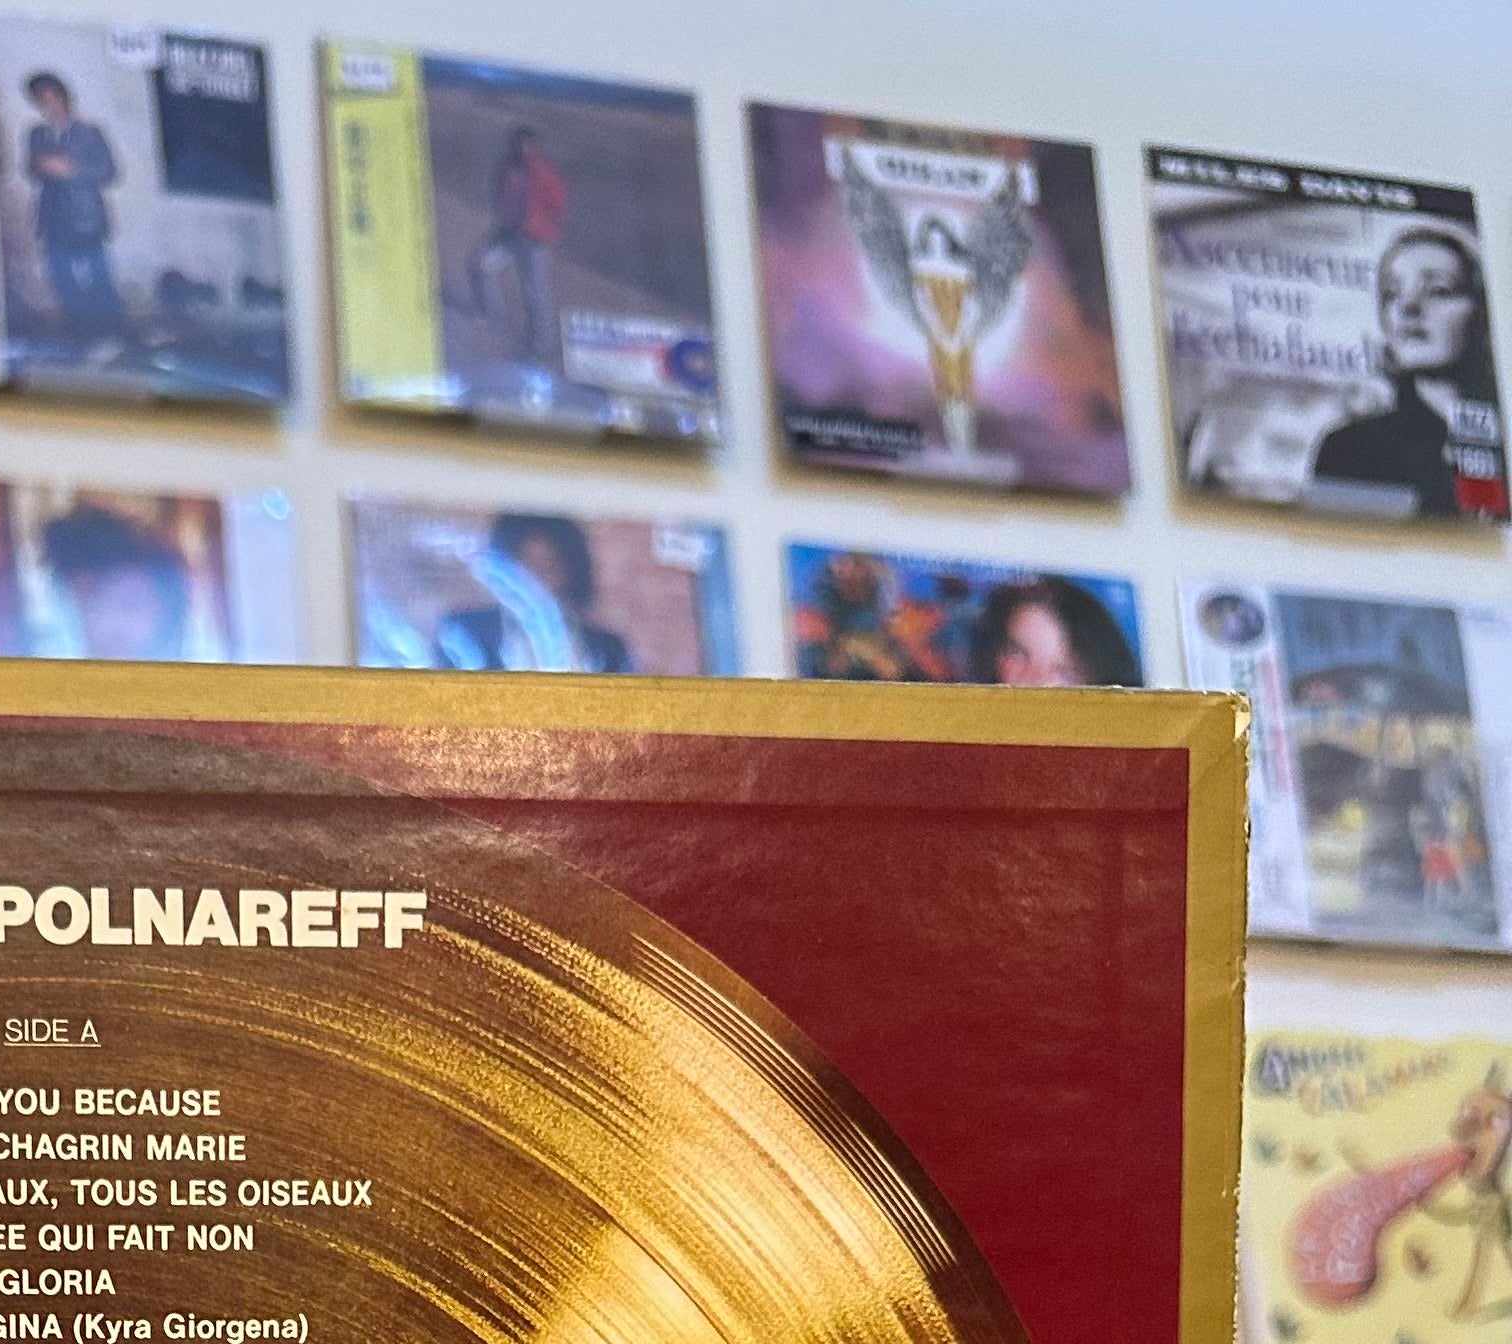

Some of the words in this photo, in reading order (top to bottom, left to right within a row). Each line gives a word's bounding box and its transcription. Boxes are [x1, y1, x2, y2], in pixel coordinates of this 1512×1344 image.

[3, 1018, 71, 1044] SIDE
[80, 1018, 99, 1043] A
[74, 1088, 221, 1117] BECAUSE
[146, 1133, 247, 1162] MARIE
[69, 1178, 158, 1207] TOUS
[170, 1179, 227, 1207] LES
[237, 1179, 372, 1207] OISEAUX
[38, 1223, 94, 1252] QUI
[108, 1224, 175, 1251] FAIT
[187, 1224, 254, 1252] NON
[73, 1313, 152, 1344] (Kyra
[163, 1312, 309, 1344] Giorgena)
